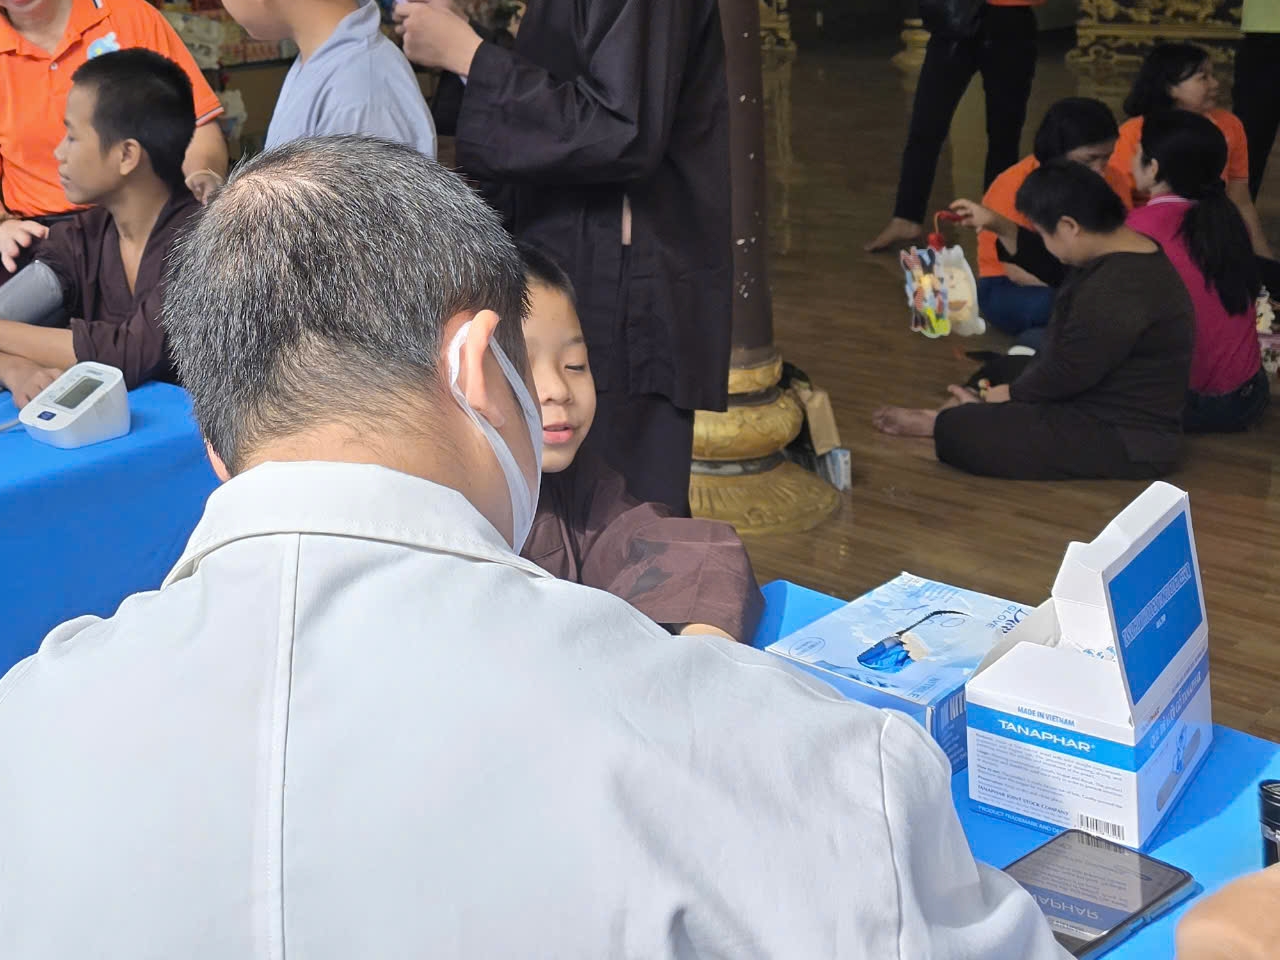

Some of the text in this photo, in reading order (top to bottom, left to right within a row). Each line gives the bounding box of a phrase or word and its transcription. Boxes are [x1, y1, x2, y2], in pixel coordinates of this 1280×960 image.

[1018, 706, 1076, 727] MADE IN VIETNAM
[1005, 813, 1039, 828] TRADEMARK
[1039, 824, 1052, 832] AND
